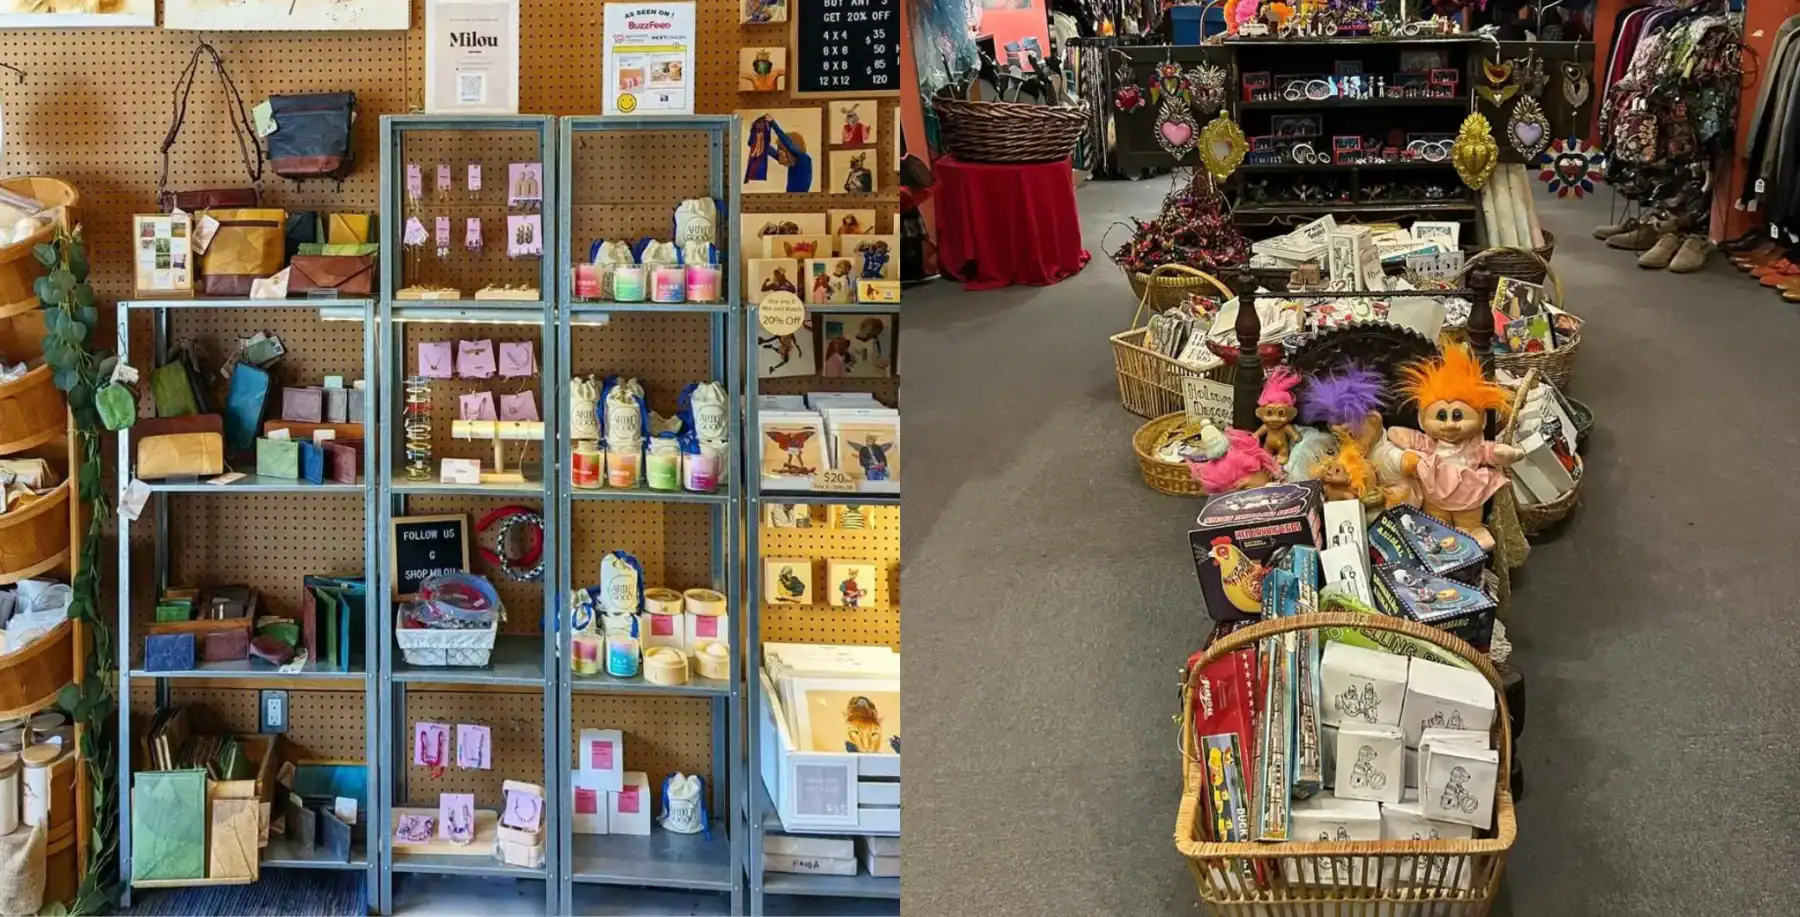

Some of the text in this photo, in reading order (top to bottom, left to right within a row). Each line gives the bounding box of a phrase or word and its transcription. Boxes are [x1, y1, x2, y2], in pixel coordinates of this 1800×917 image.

[624, 11, 635, 19] AS
[636, 8, 657, 16] SEEN
[658, 9, 670, 17] ON
[823, 11, 891, 22] GET 20% OFF
[449, 30, 499, 47] Milou
[822, 30, 830, 41] 4
[841, 30, 848, 40] 4
[872, 28, 886, 39] 35
[873, 44, 886, 54] 50
[822, 60, 830, 71] 8
[841, 60, 848, 71] 8
[819, 76, 829, 86] 12
[840, 75, 850, 86] 12
[872, 74, 888, 85] 120
[867, 260, 881, 271] 17
[763, 315, 801, 325] 20% Off
[823, 472, 845, 483] $20
[403, 528, 455, 541] FOLLOW US
[1236, 807, 1249, 837] DUCK
